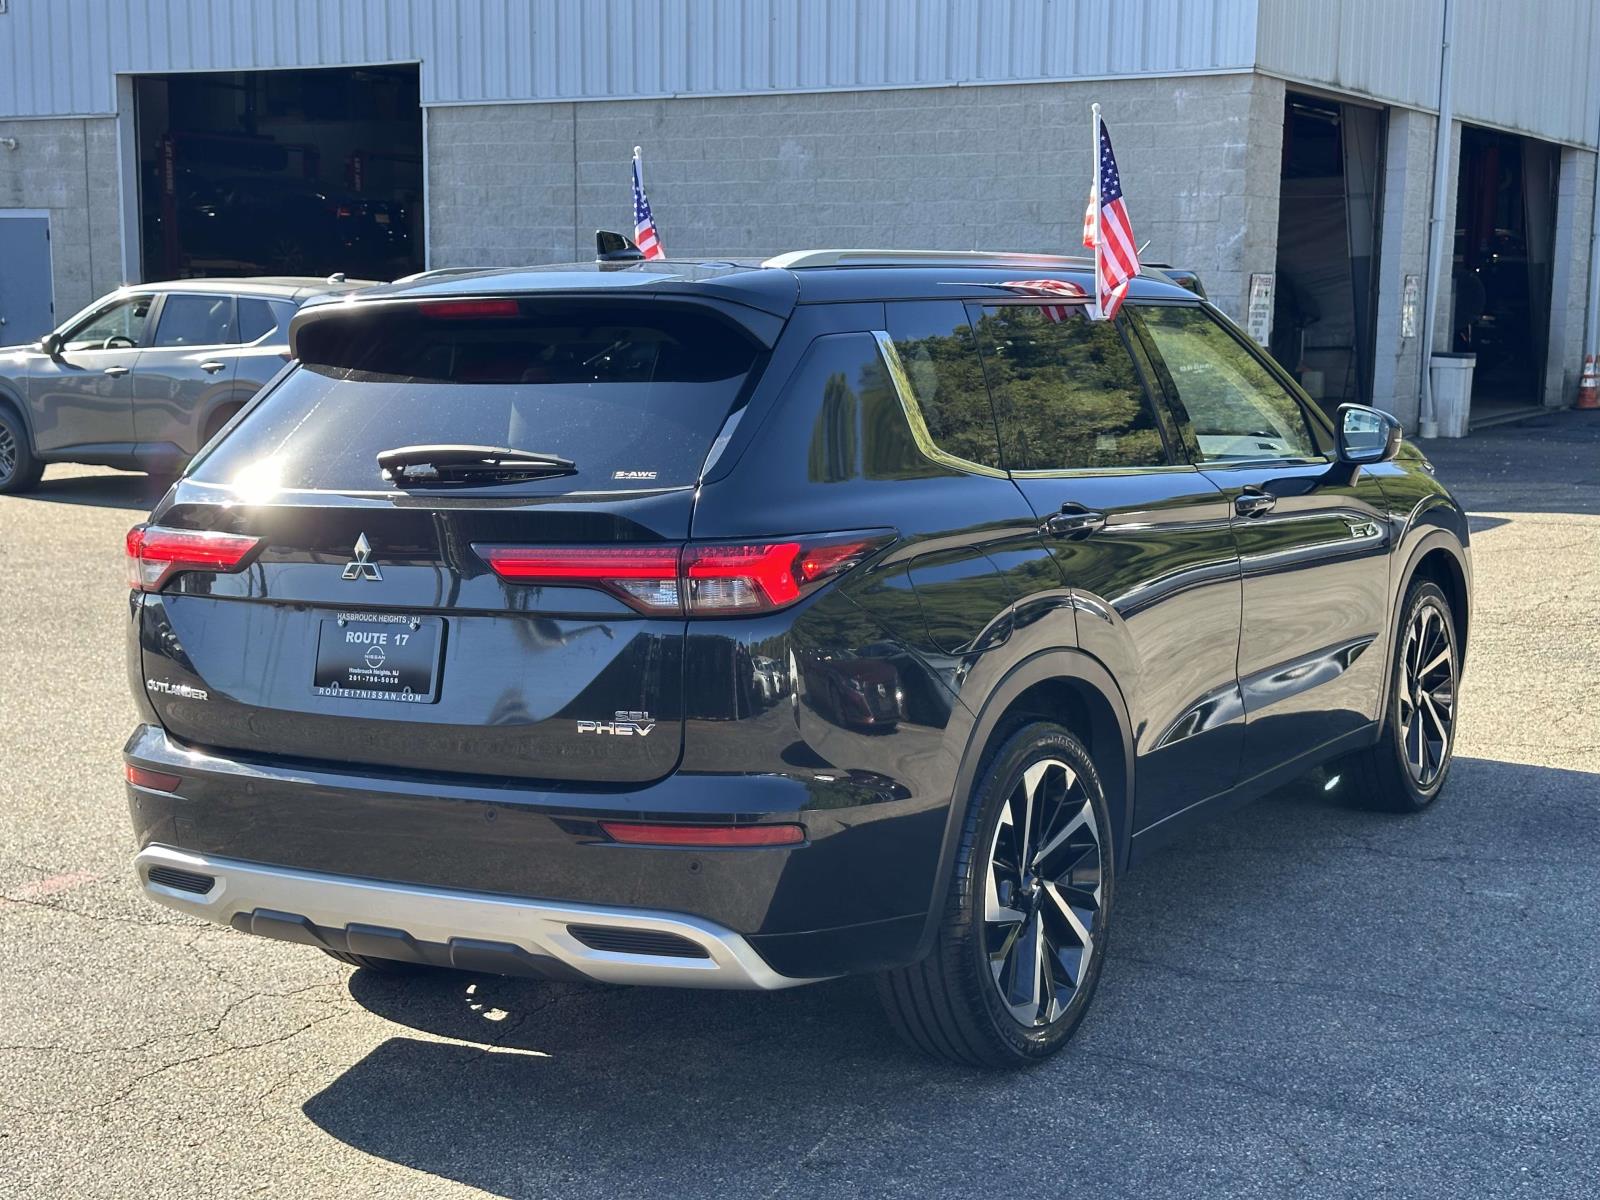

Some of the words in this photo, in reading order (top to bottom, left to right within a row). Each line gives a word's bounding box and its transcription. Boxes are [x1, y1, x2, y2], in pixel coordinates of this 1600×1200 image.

[337, 612, 378, 622] HASBROUCK
[345, 631, 388, 645] ROUTE
[394, 633, 410, 646] 17
[146, 679, 208, 701] OUTLANDER
[319, 687, 422, 703] ROUTE17NISSAN.COM
[615, 710, 655, 722] SEL
[577, 720, 656, 737] PHEV
